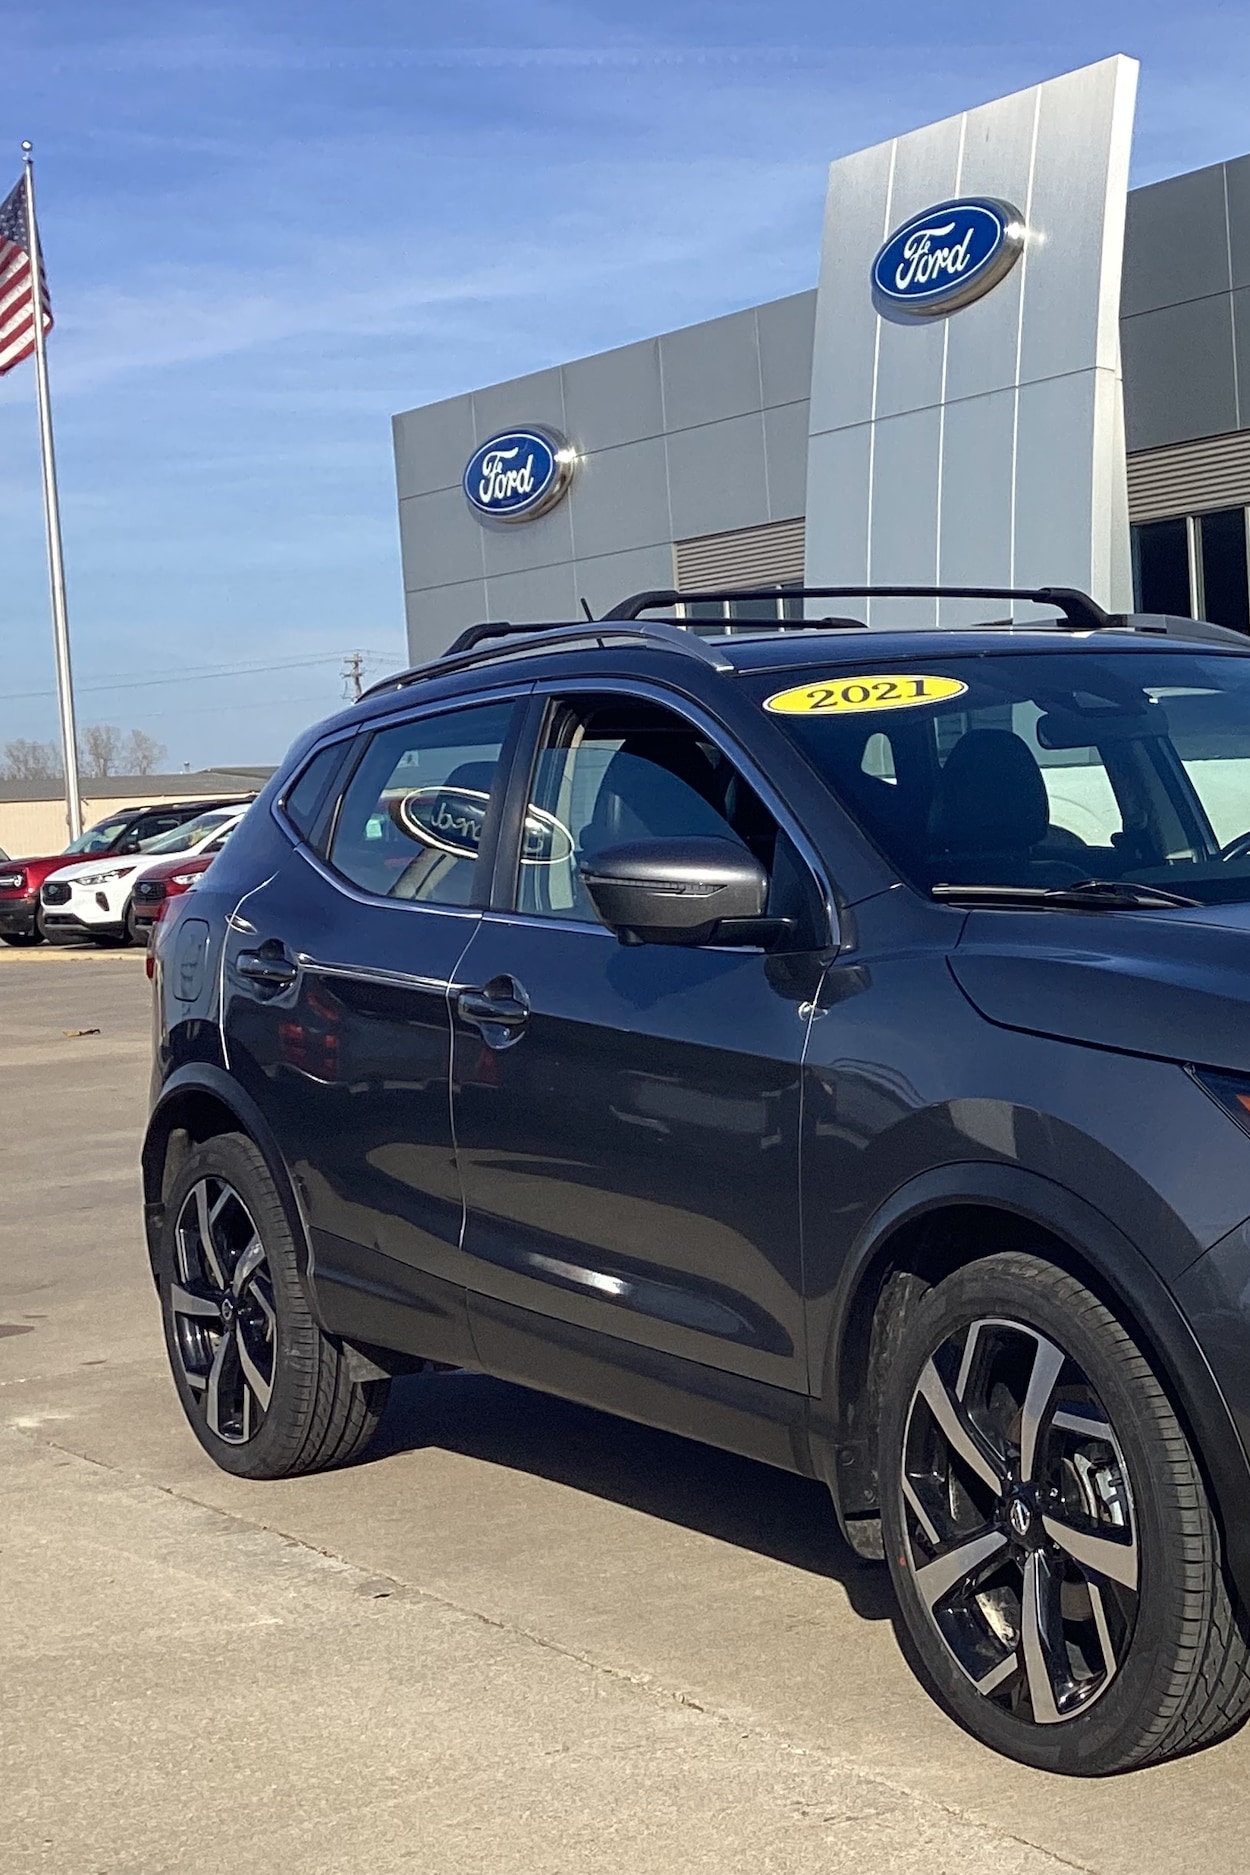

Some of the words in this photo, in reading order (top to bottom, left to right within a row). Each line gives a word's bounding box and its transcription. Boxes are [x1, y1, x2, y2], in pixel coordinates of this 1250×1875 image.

[895, 221, 971, 290] Ford
[478, 446, 534, 503] Ford
[807, 679, 932, 710] 2021
